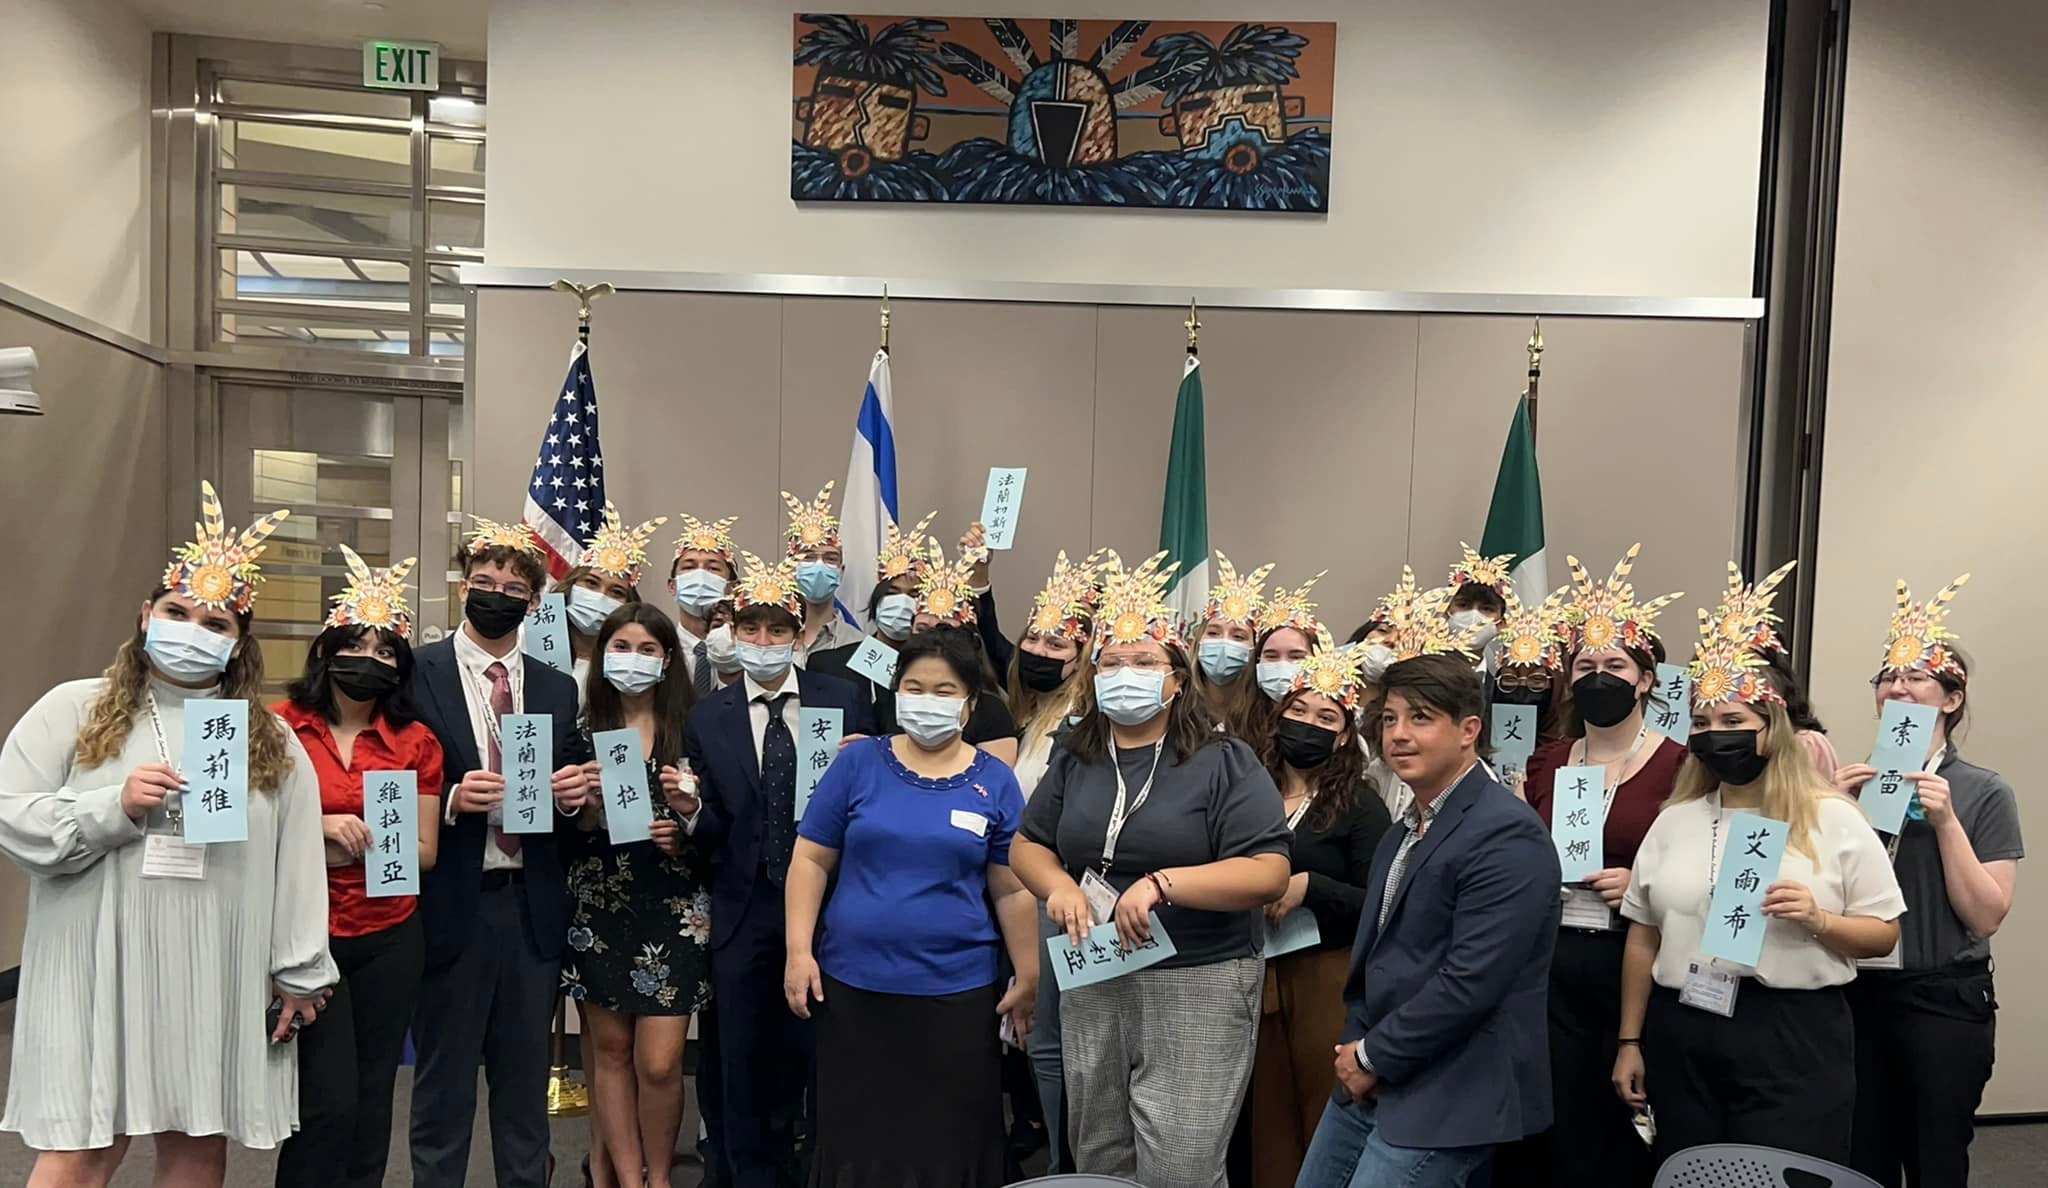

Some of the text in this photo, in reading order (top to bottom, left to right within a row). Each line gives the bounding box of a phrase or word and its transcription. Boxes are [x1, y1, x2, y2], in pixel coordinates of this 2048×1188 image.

[376, 47, 431, 84] EXIT
[1655, 675, 1684, 731] 吉那
[201, 713, 237, 813] 瑪莉雅
[609, 743, 640, 809] 雷拉
[1880, 716, 1919, 795] 索雷
[376, 780, 407, 885] 維拉利亞
[1564, 777, 1590, 861] 卡妮娜
[1723, 828, 1770, 940] 艾爾希
